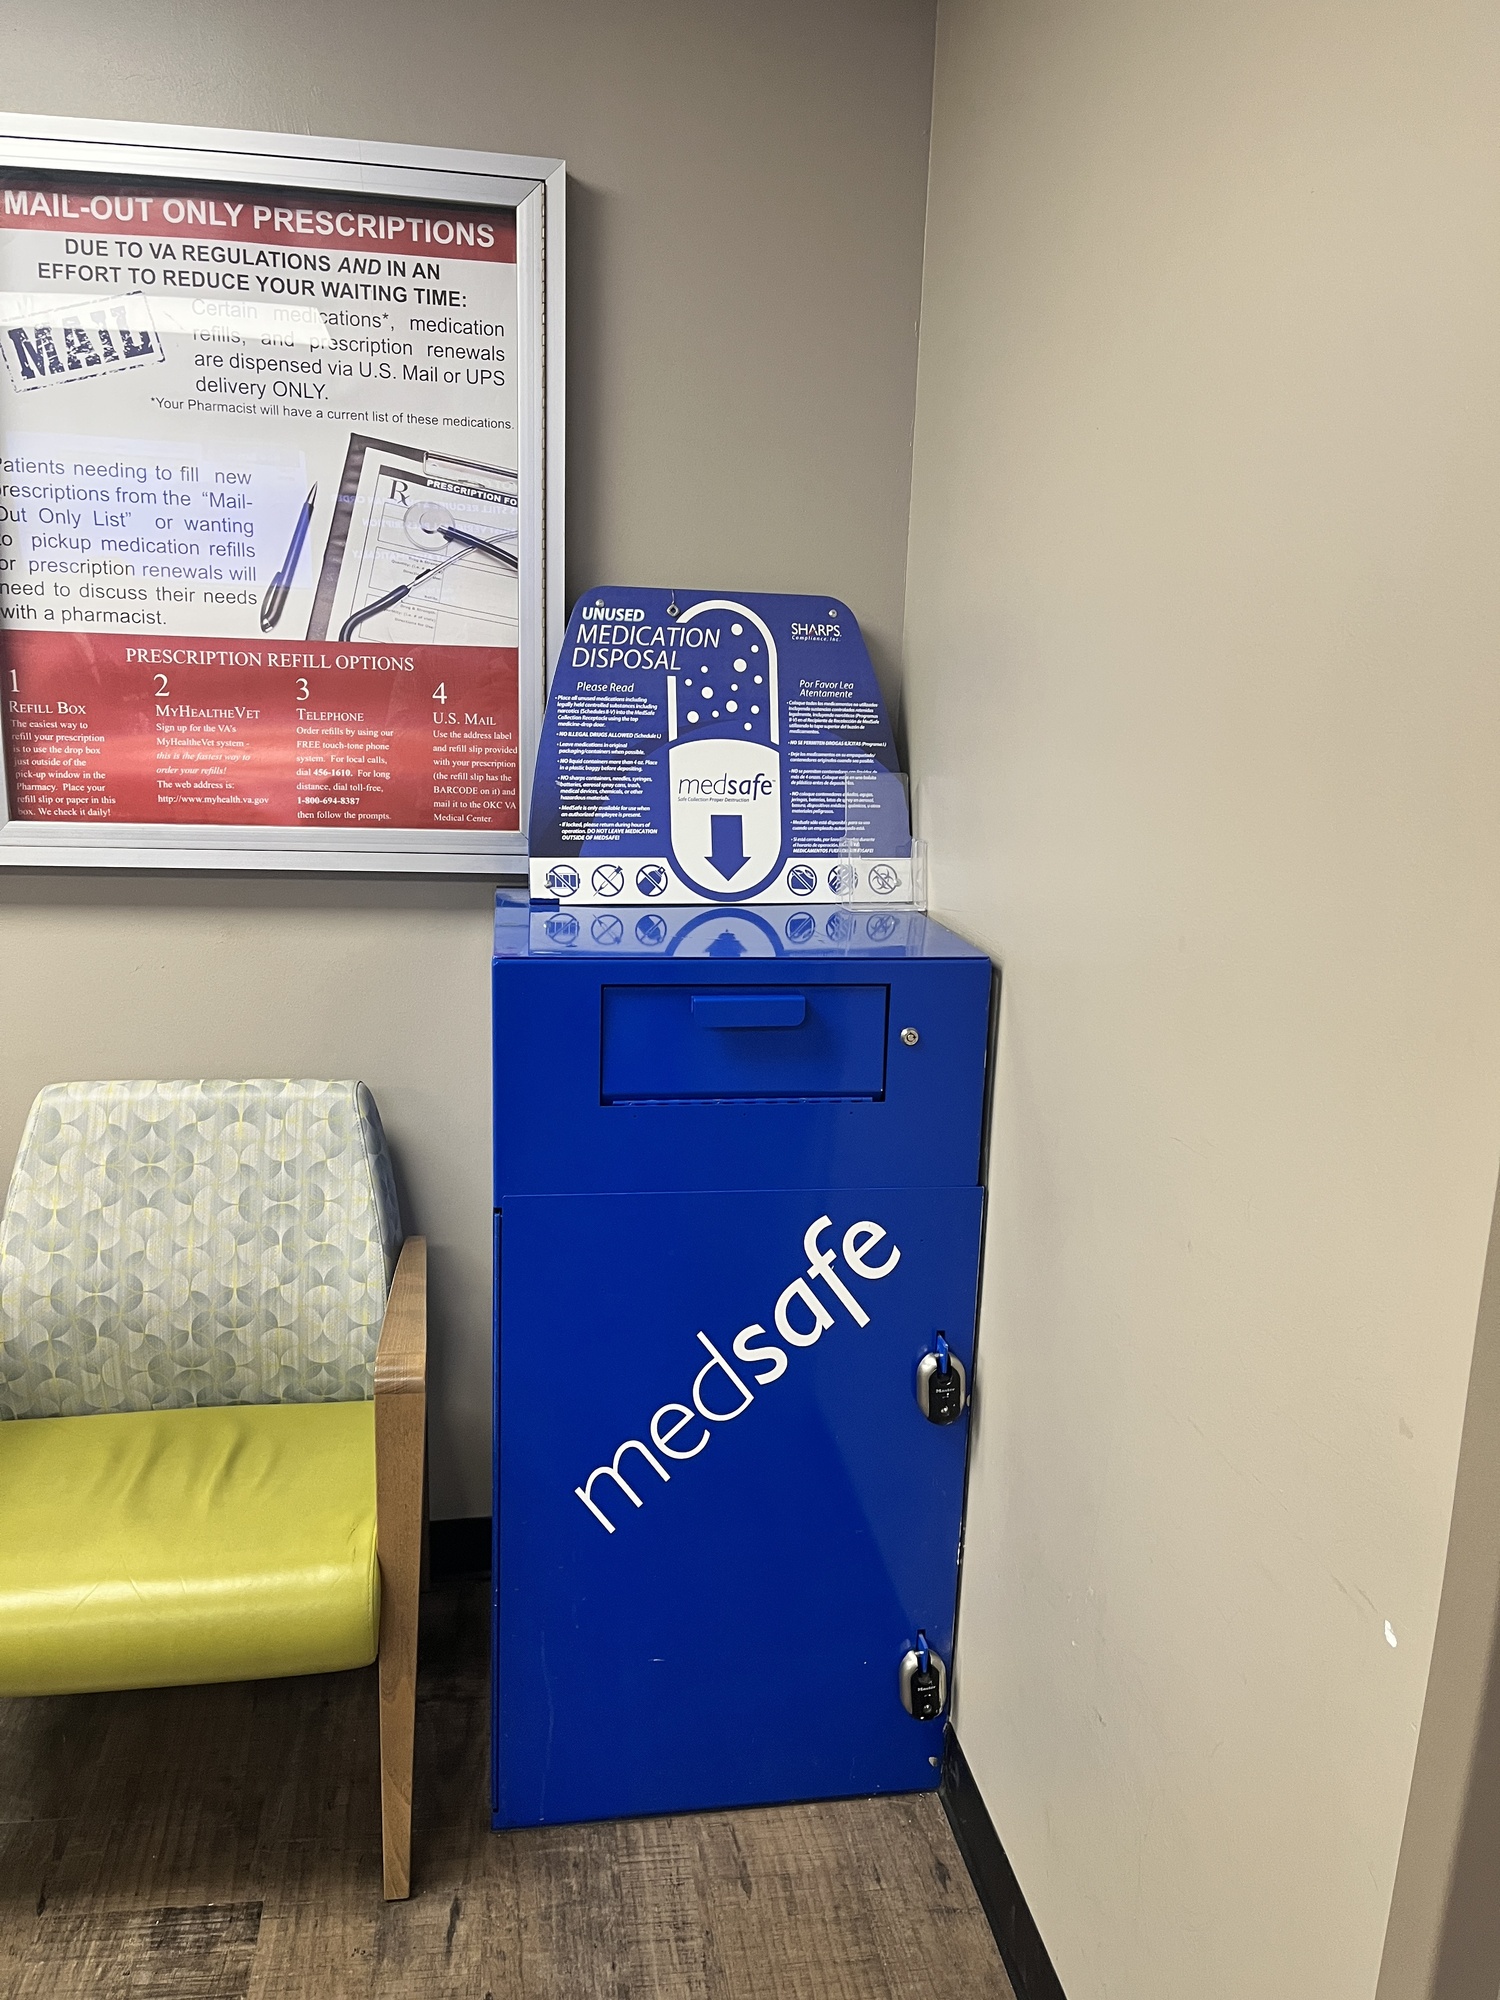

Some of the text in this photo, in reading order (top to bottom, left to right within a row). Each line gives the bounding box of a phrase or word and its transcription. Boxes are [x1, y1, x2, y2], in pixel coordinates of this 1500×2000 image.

[4, 191, 494, 248] MAIL-OUT ONLY PRESCRIPTIONS
[65, 239, 439, 279] DUE TO VA REGULATIONS AND IN AN
[38, 263, 466, 306] EFFORT TO REDUCE YOUR WAITING TIME:
[192, 299, 257, 319] Certain
[410, 318, 504, 336] medication
[7, 305, 155, 380] MAIL
[193, 326, 504, 361] refills, and prescription renewals
[194, 353, 504, 385] are dispensed via U.S. Mail or UPS
[196, 376, 328, 399] delivery ONLY.
[188, 399, 256, 413] Pharmacist
[260, 405, 278, 415] will
[283, 406, 312, 417] have
[316, 410, 323, 418] a
[327, 411, 368, 420] current
[372, 411, 388, 422] list
[392, 412, 403, 422] of
[407, 414, 438, 425] these
[442, 417, 514, 429] medications.
[0, 458, 251, 484] atients needing to fill new
[0, 484, 252, 508] rescriptions from the “Mail-
[426, 480, 501, 502] PRESCRIPTION
[504, 496, 517, 506] FO
[0, 506, 253, 537] Out Only List” or wanting
[32, 533, 91, 552] pickup
[101, 537, 199, 554] medication
[210, 542, 255, 557] refills
[0, 558, 255, 581] or prescription renewals will
[0, 582, 257, 604] need to discuss their needs
[1, 603, 166, 624] with a pharmacist.
[582, 607, 644, 621] UNUSED
[576, 624, 720, 647] MEDICATION
[791, 623, 840, 637] SHARPS
[126, 648, 414, 670] PRESCRIPTION REFILL OPTIONS
[572, 648, 680, 669] DISPOSAL
[9, 669, 20, 693] 1
[153, 673, 170, 697] 2
[295, 678, 310, 701] 3
[576, 682, 634, 692] Please Read
[799, 679, 853, 689] Por Favor Lea
[432, 682, 447, 704] 4
[800, 689, 852, 697] Atentamente
[29, 720, 57, 728] easiest
[156, 723, 174, 733] Sign
[203, 724, 215, 732] the
[433, 730, 447, 738] Use
[12, 732, 31, 740] refill
[56, 734, 104, 743] prescription
[366, 742, 389, 751] phone
[156, 780, 172, 788] The
[174, 780, 191, 788] web
[313, 768, 352, 776] 456-1610.
[357, 769, 371, 777] For
[373, 770, 390, 779] long
[434, 786, 477, 794] BARCODE
[678, 772, 772, 800] medsafe
[158, 795, 268, 804] http://www.myhealth.va.gov
[466, 814, 492, 822] Center.
[574, 1215, 901, 1534] medsafe
